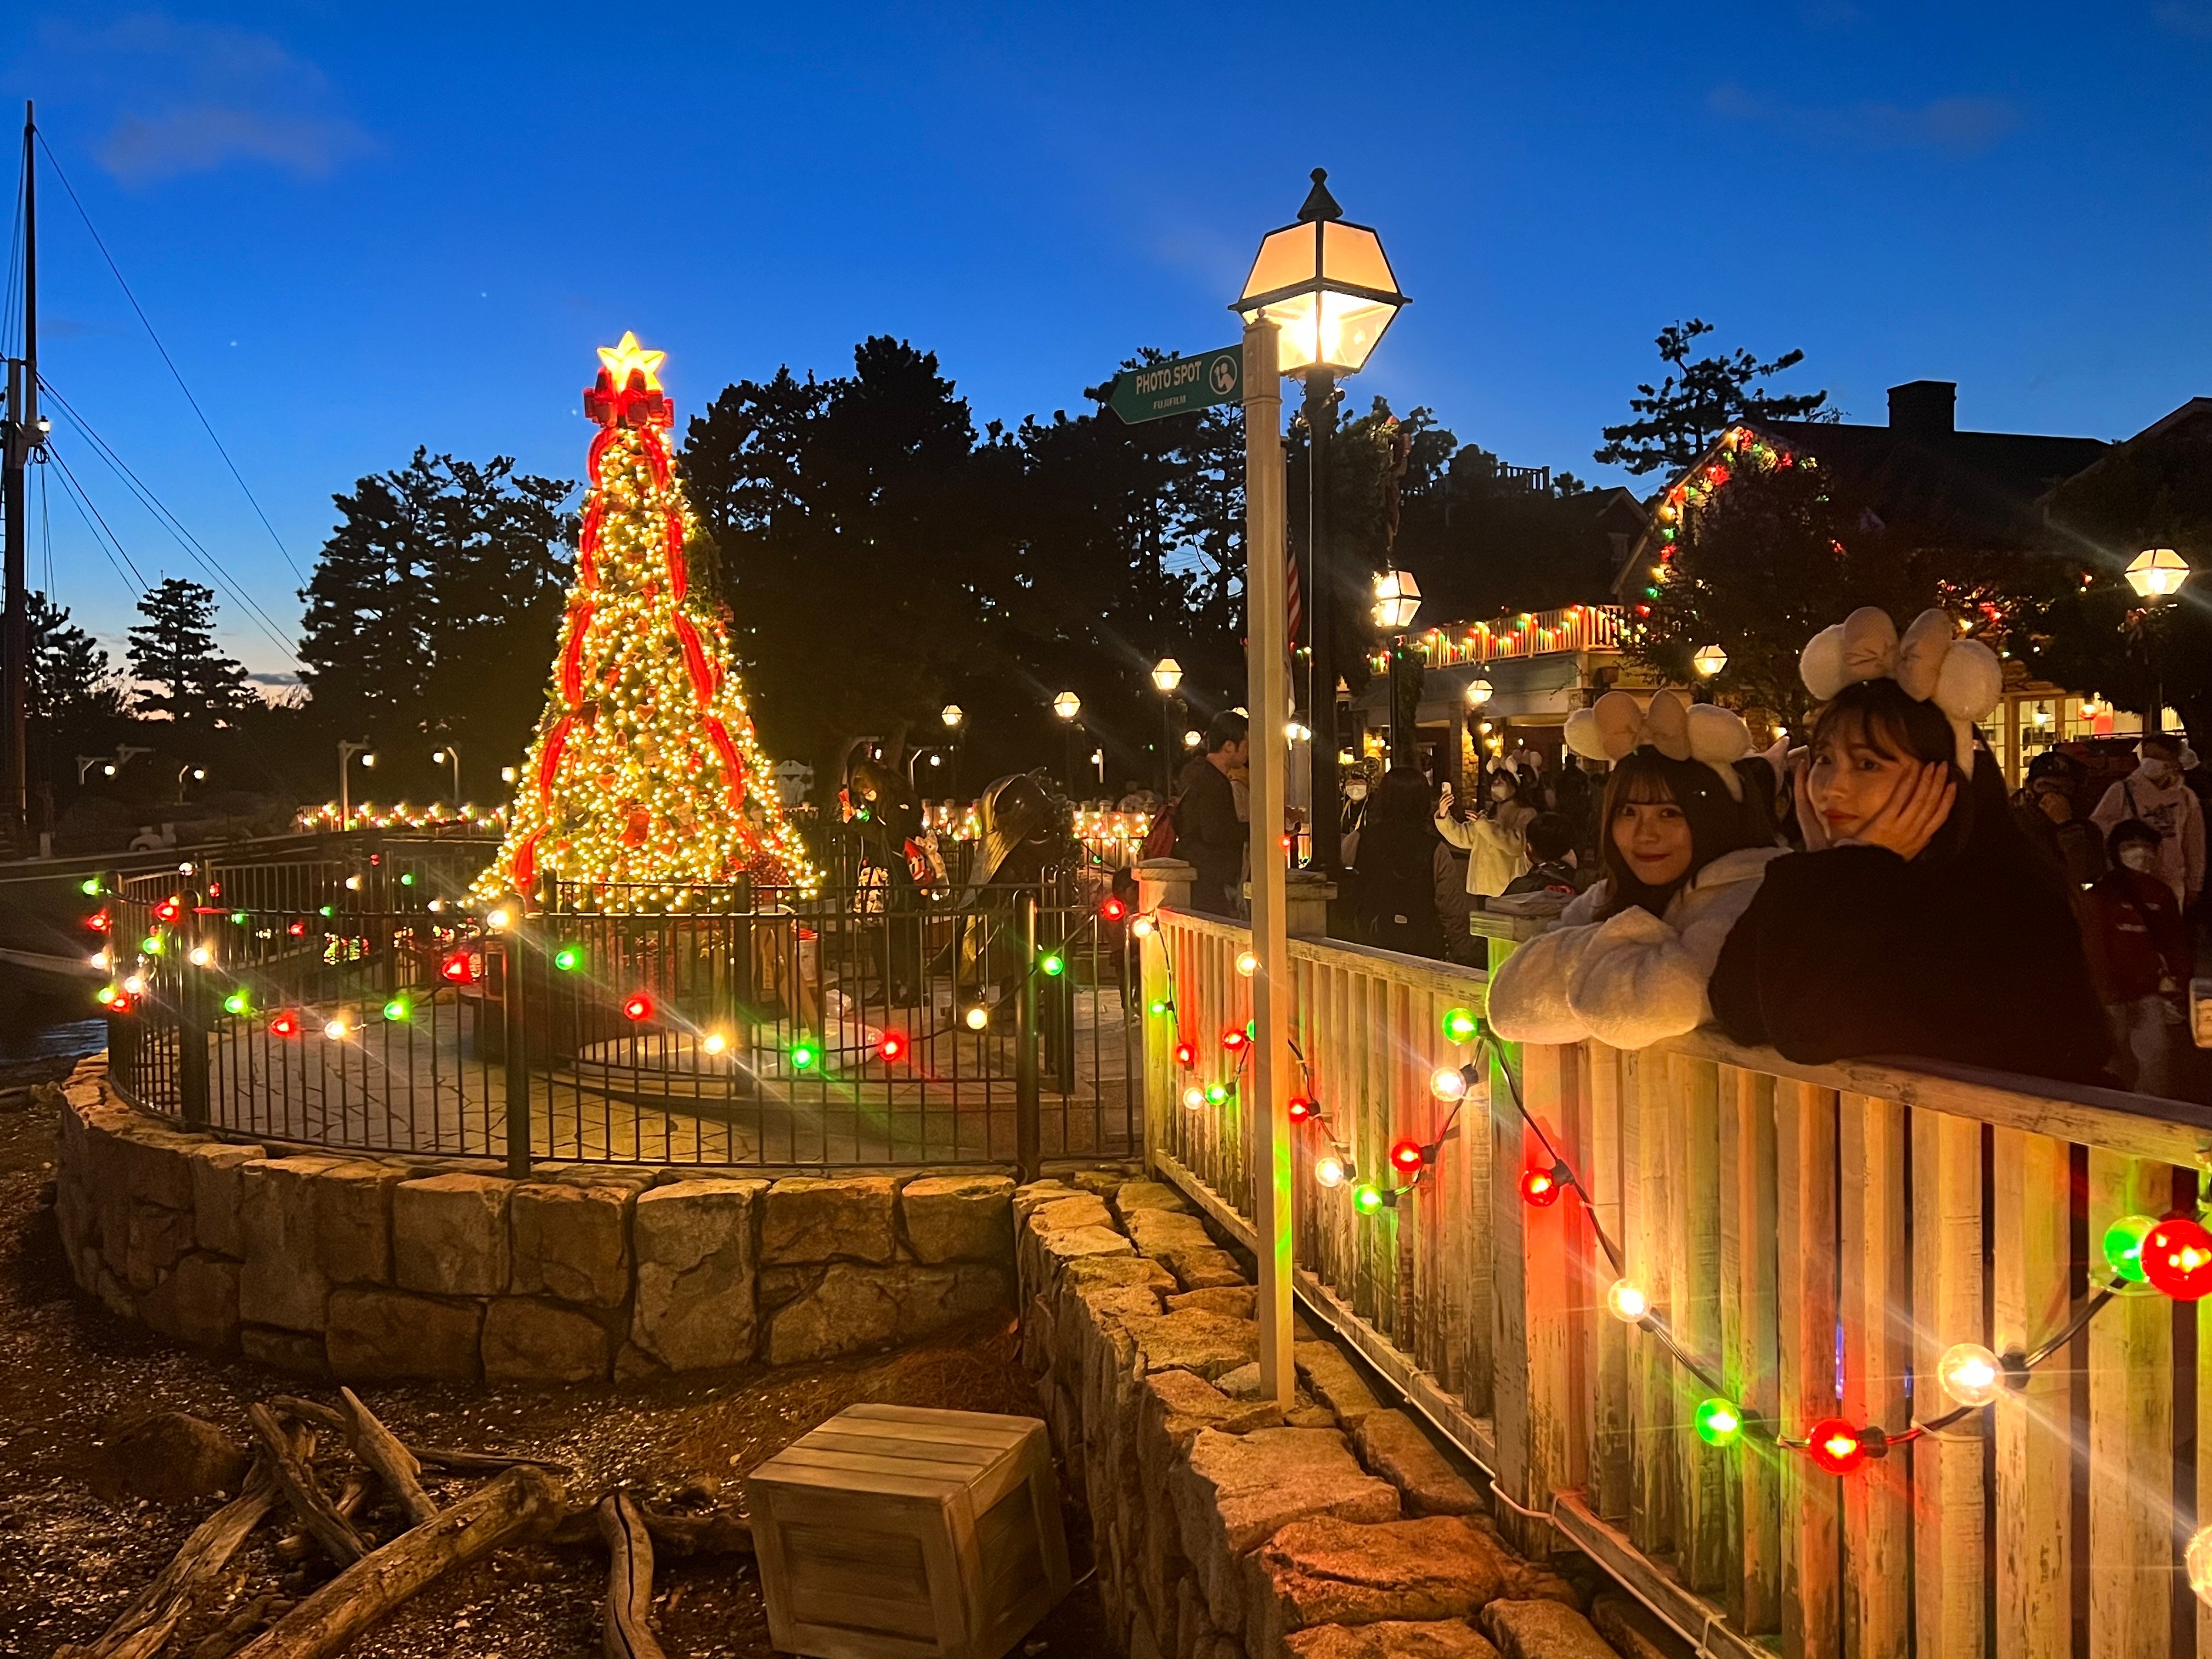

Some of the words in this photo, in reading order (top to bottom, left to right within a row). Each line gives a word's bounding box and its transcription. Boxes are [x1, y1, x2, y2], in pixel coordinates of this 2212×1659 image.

[1136, 369, 1171, 394] PHOTO
[1173, 360, 1201, 386] SPOT
[1153, 395, 1186, 410] FUJIFILM
